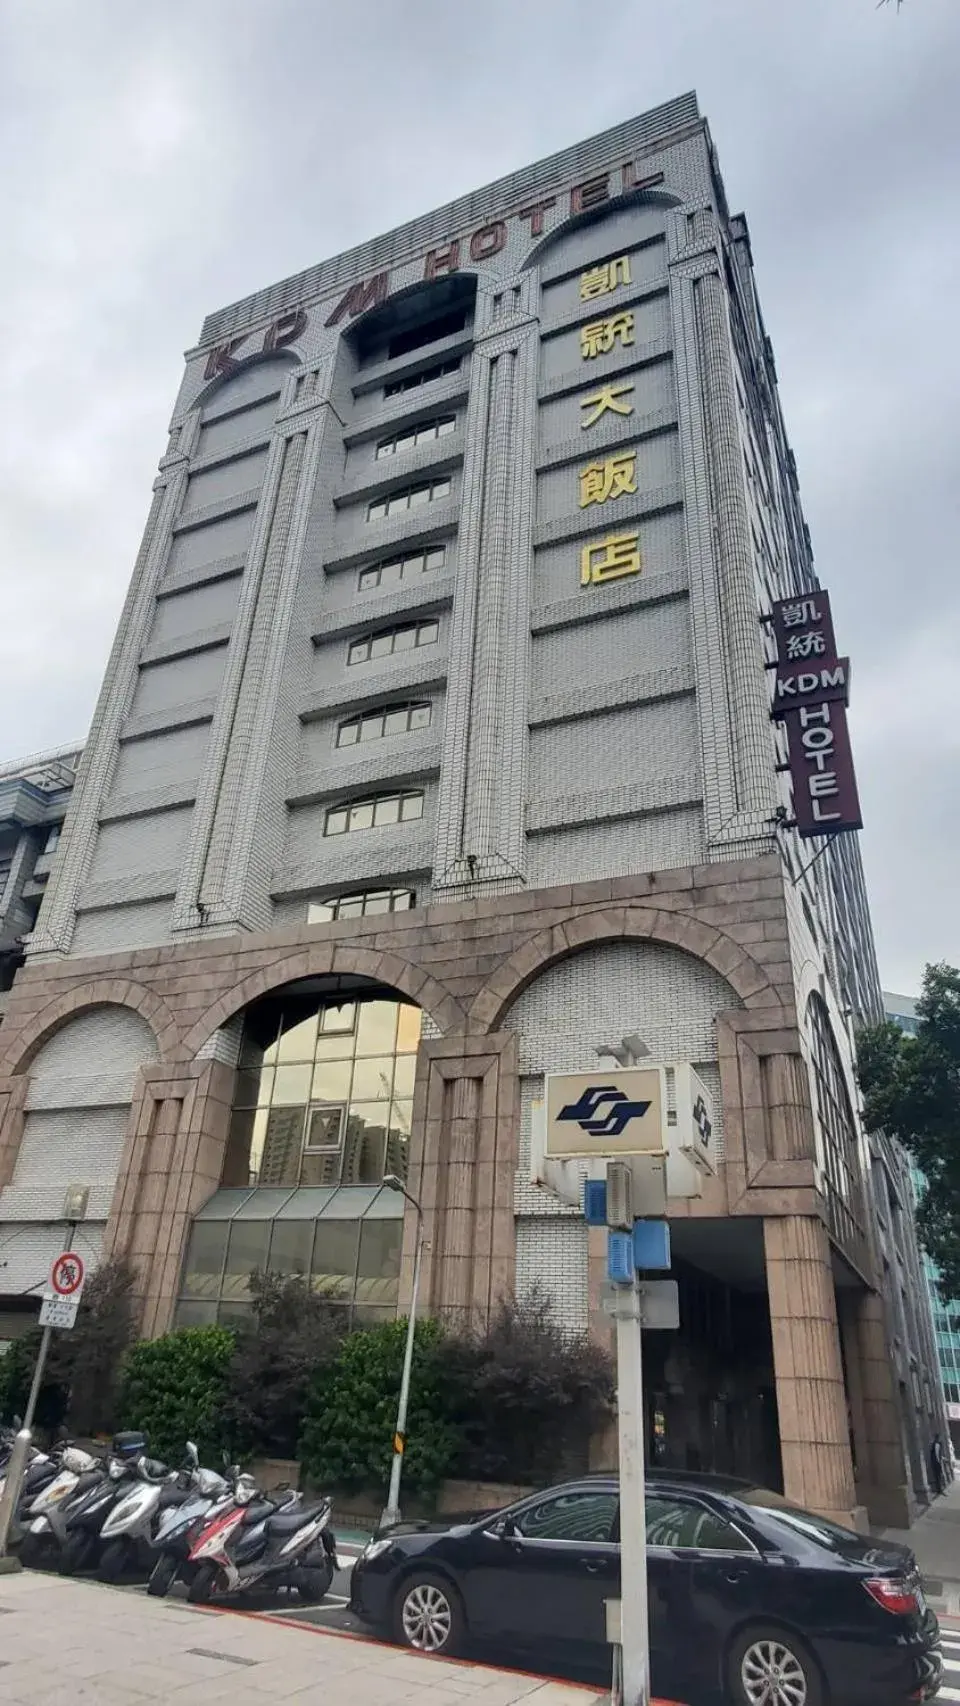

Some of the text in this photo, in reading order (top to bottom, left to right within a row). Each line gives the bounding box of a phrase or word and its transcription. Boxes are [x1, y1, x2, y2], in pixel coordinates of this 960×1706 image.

[424, 160, 665, 281] HOTEL
[579, 254, 642, 586] 凱統大飯店
[777, 667, 845, 697] KDM
[781, 599, 825, 659] 凱統
[800, 703, 841, 821] HOTEL
